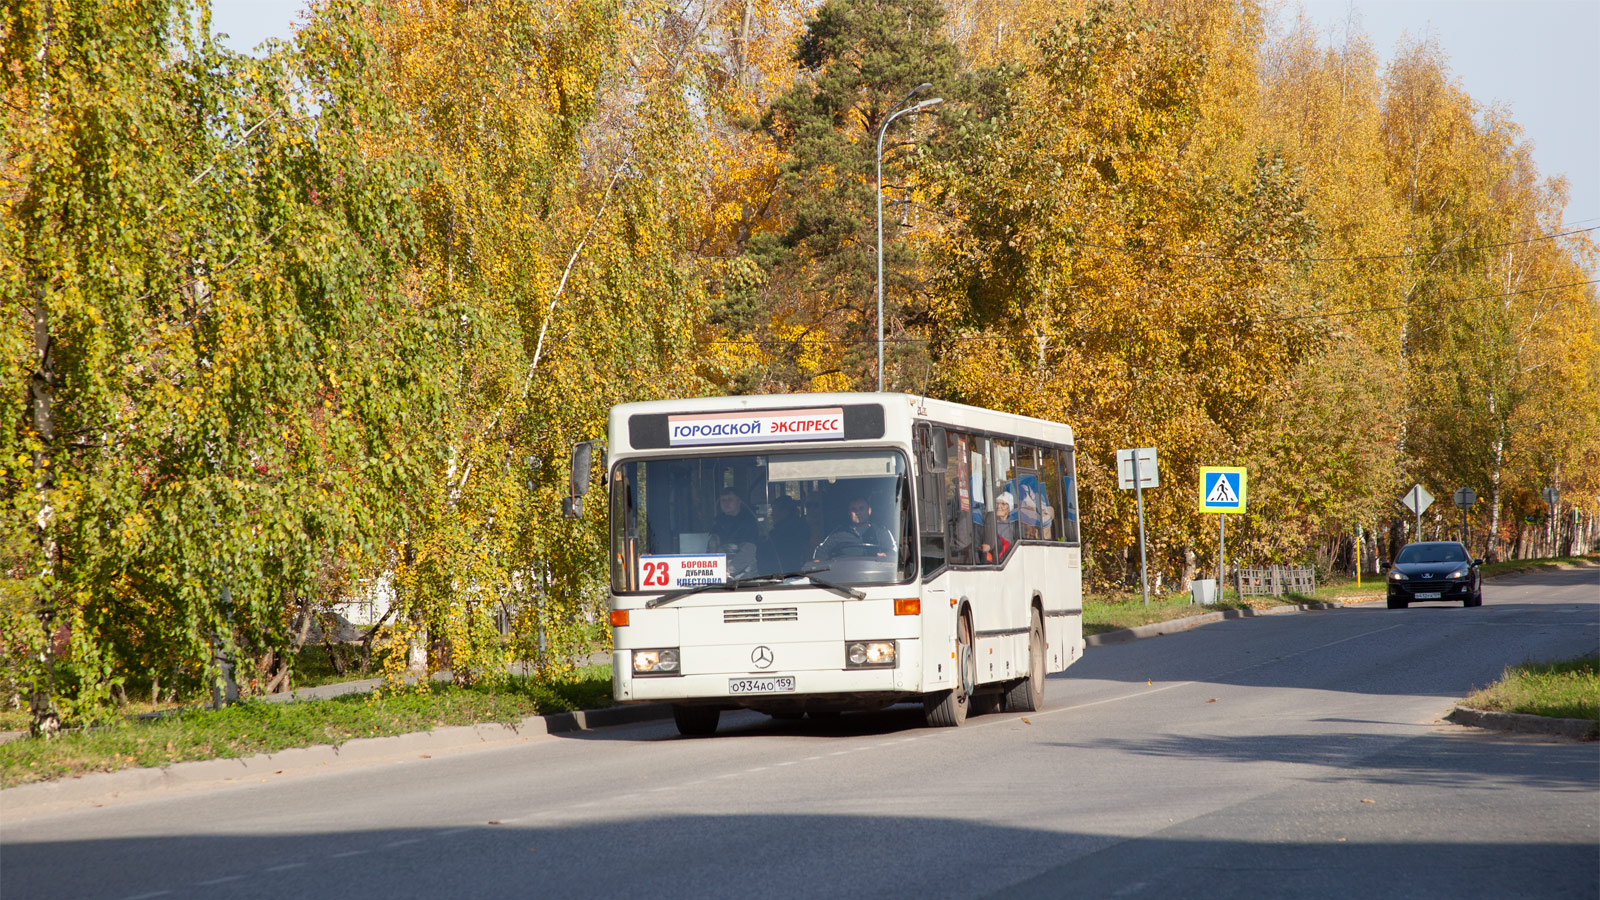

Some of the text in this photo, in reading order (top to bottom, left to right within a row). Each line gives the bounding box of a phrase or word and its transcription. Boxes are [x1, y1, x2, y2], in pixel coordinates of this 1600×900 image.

[674, 419, 838, 437] ГОРОДСКОЙ ЭКСПРЕСС
[681, 560, 718, 568] БОРОВАЯ
[643, 561, 670, 586] 23
[685, 569, 714, 577] ДУБРАВА
[732, 678, 792, 692] О934АО 159
